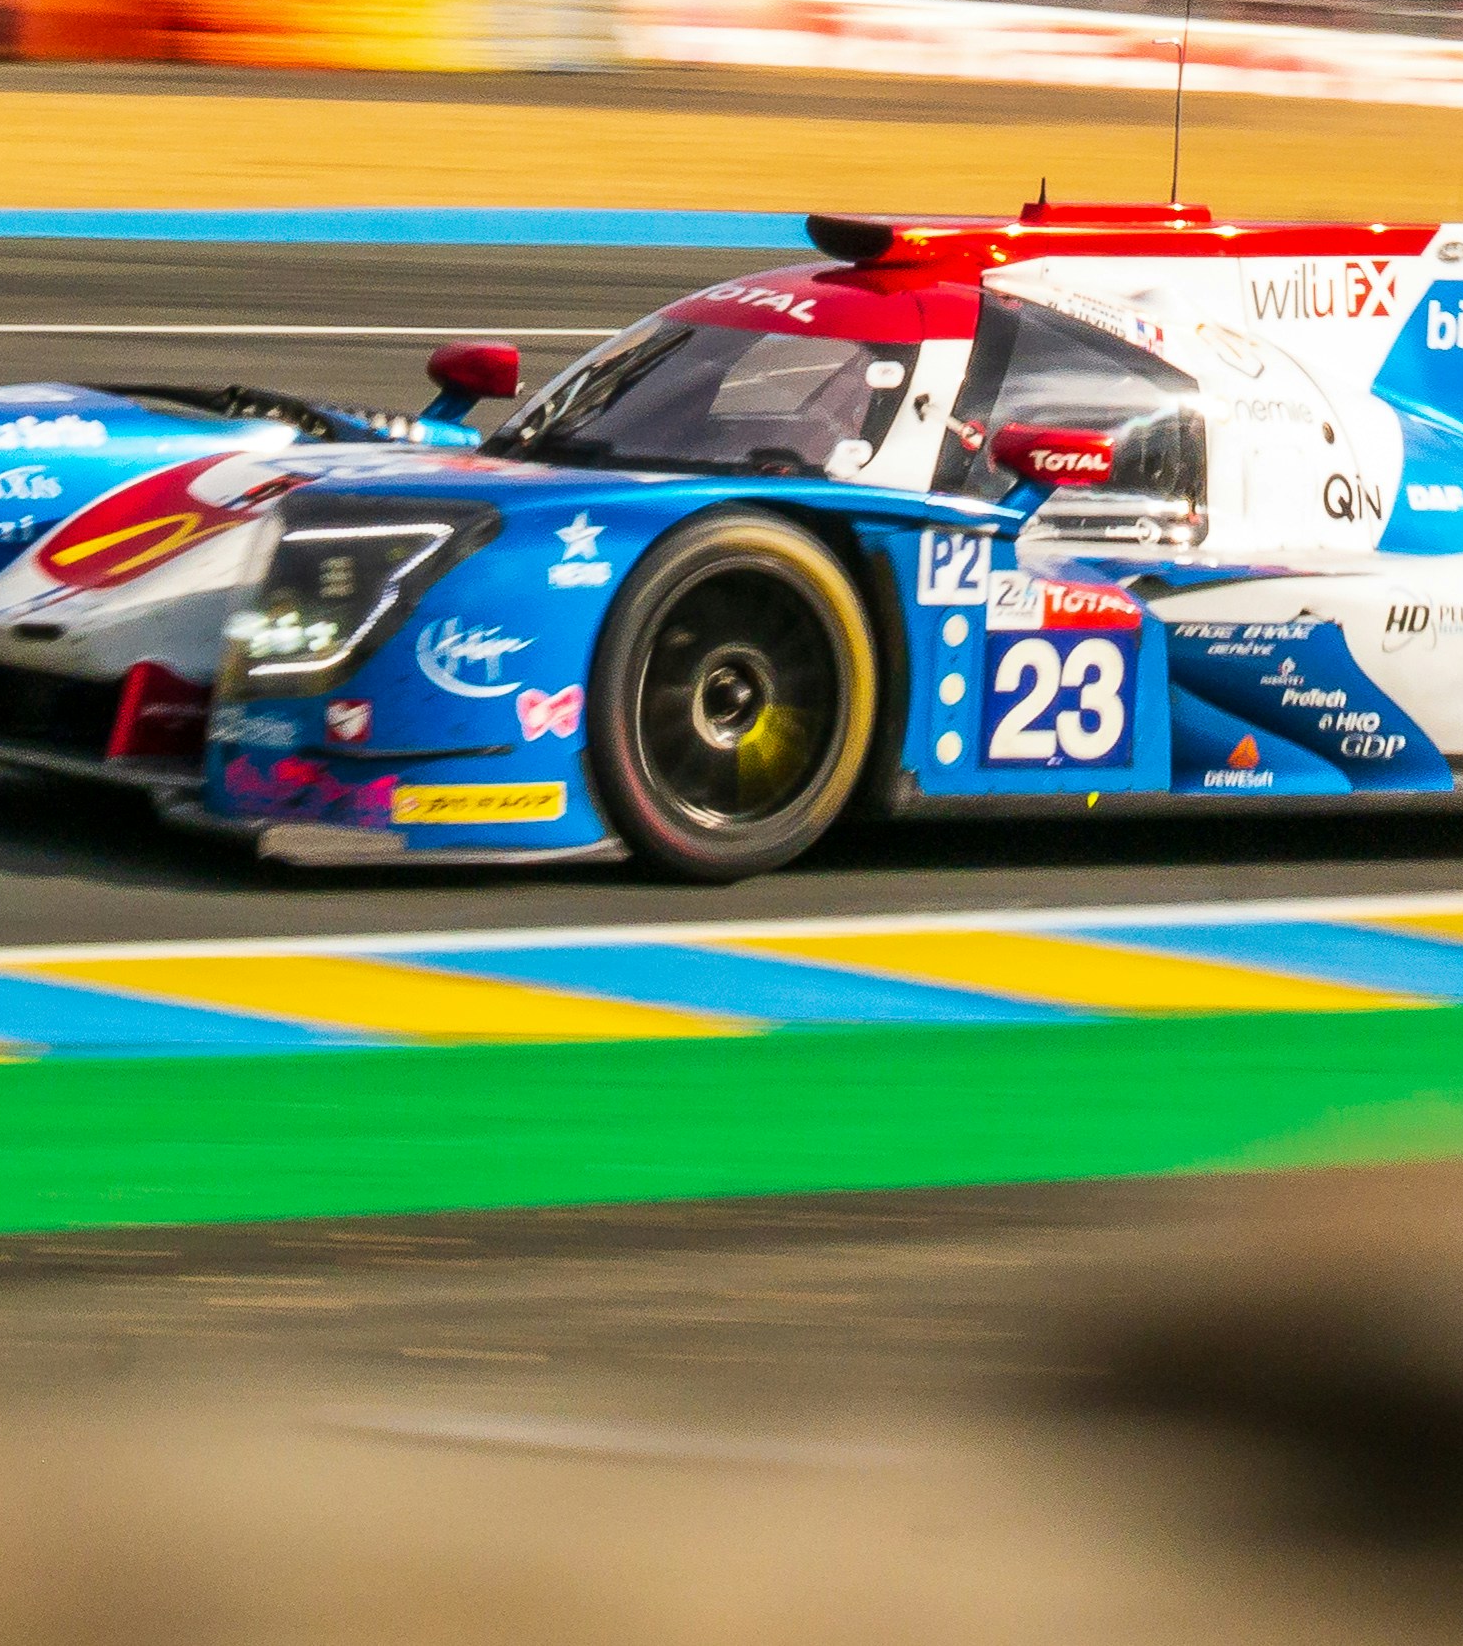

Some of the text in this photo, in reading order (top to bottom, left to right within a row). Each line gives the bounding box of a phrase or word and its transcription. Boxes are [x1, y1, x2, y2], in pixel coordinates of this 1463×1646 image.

[1344, 260, 1397, 318] FX
[1029, 450, 1111, 472] TOTAL
[930, 536, 980, 590] P2
[1385, 605, 1431, 632] HD
[989, 638, 1125, 760] 23
[1340, 734, 1406, 760] GDP
